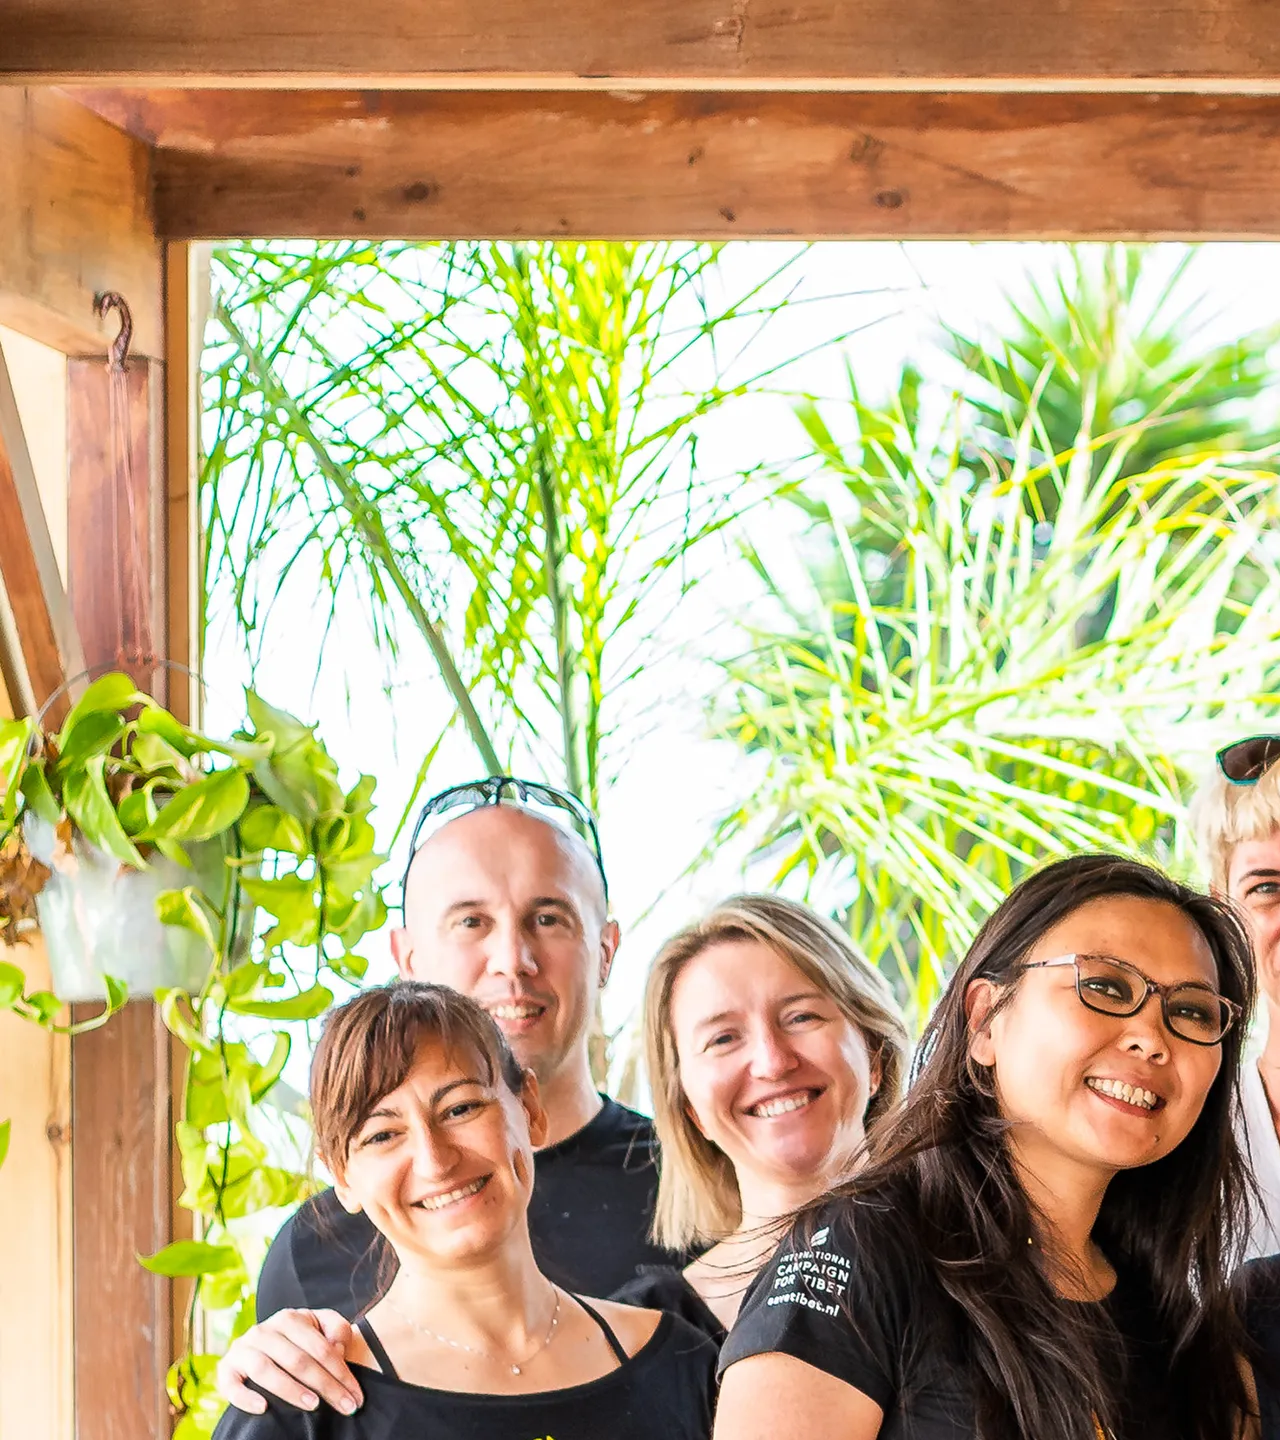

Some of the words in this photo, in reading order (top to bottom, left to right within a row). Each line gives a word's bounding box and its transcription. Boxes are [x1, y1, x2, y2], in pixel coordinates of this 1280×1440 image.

[780, 1250, 851, 1268] INTRNTIONAL
[777, 1261, 849, 1282] CAMPAIGN
[774, 1274, 796, 1289] FOR
[803, 1274, 846, 1296] TIBET
[767, 1292, 840, 1317] savetibet.nl
